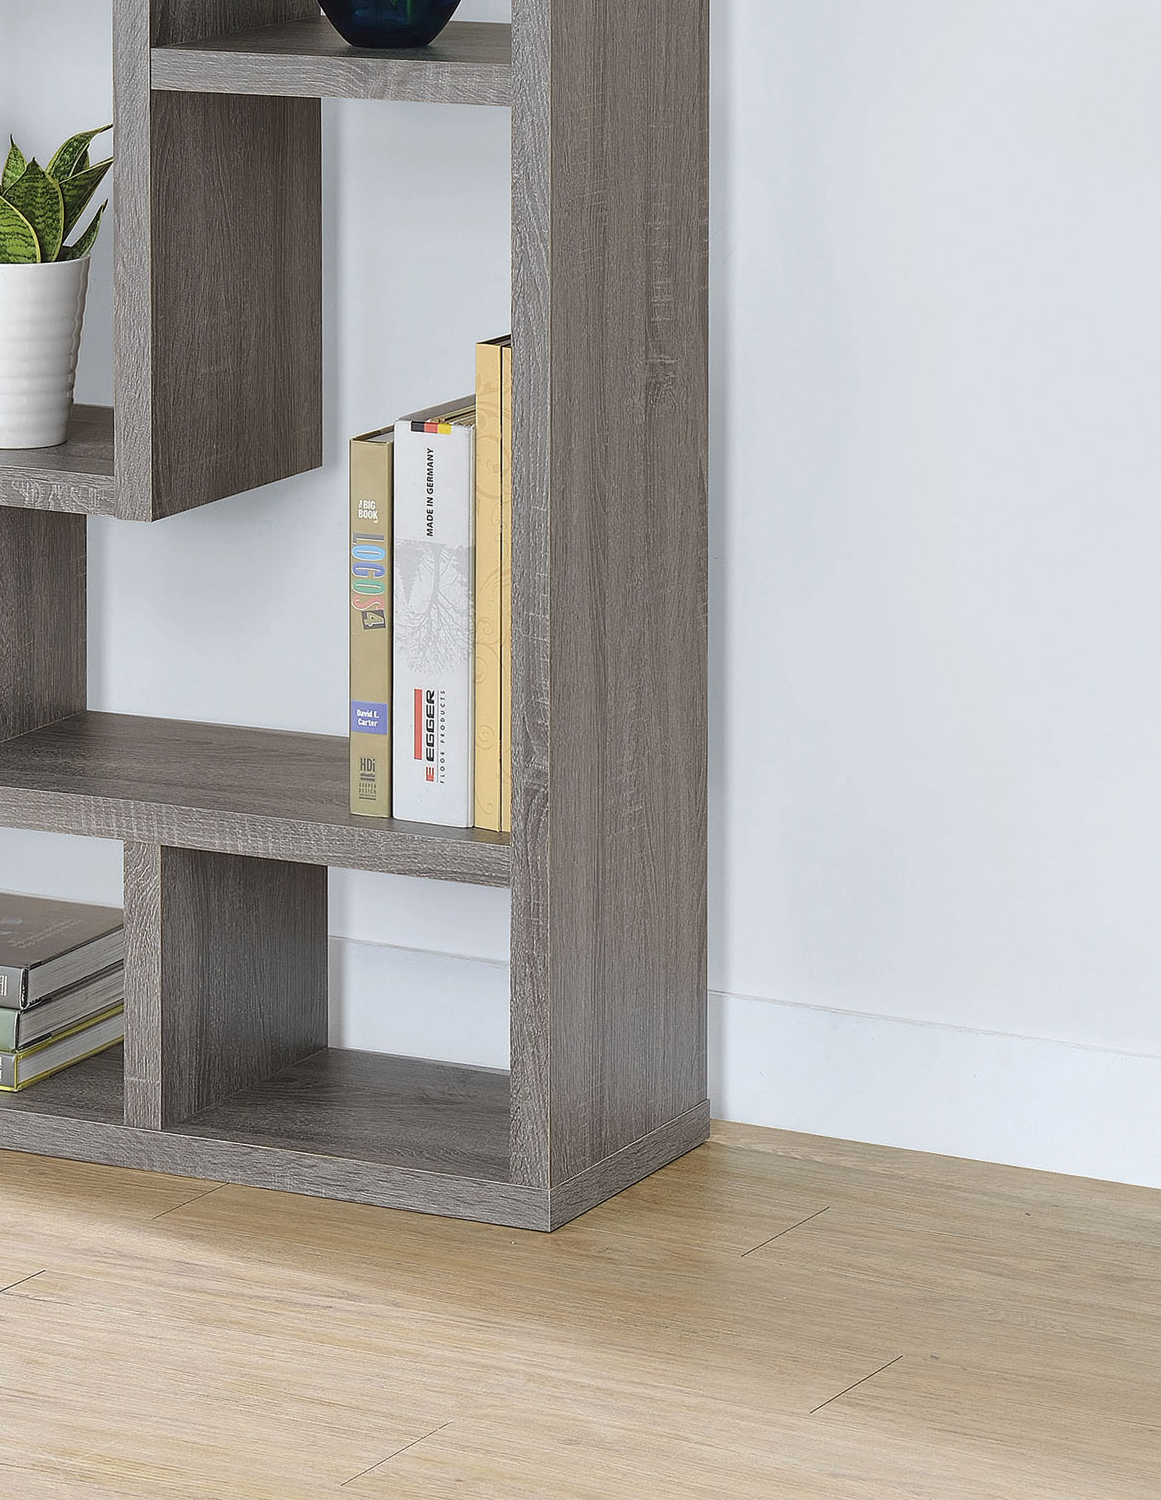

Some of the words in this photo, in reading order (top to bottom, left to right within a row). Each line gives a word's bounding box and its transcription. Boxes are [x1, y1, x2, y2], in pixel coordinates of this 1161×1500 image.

[426, 447, 434, 495] GERMANY
[363, 500, 376, 510] BIG
[426, 496, 434, 508] IN
[358, 509, 378, 520] BOOK
[426, 509, 434, 537] MADE
[351, 532, 386, 612] LOGOS
[356, 708, 373, 718] David
[357, 718, 379, 727] Carter
[425, 689, 435, 762] EGGER
[360, 757, 376, 773] HDi
